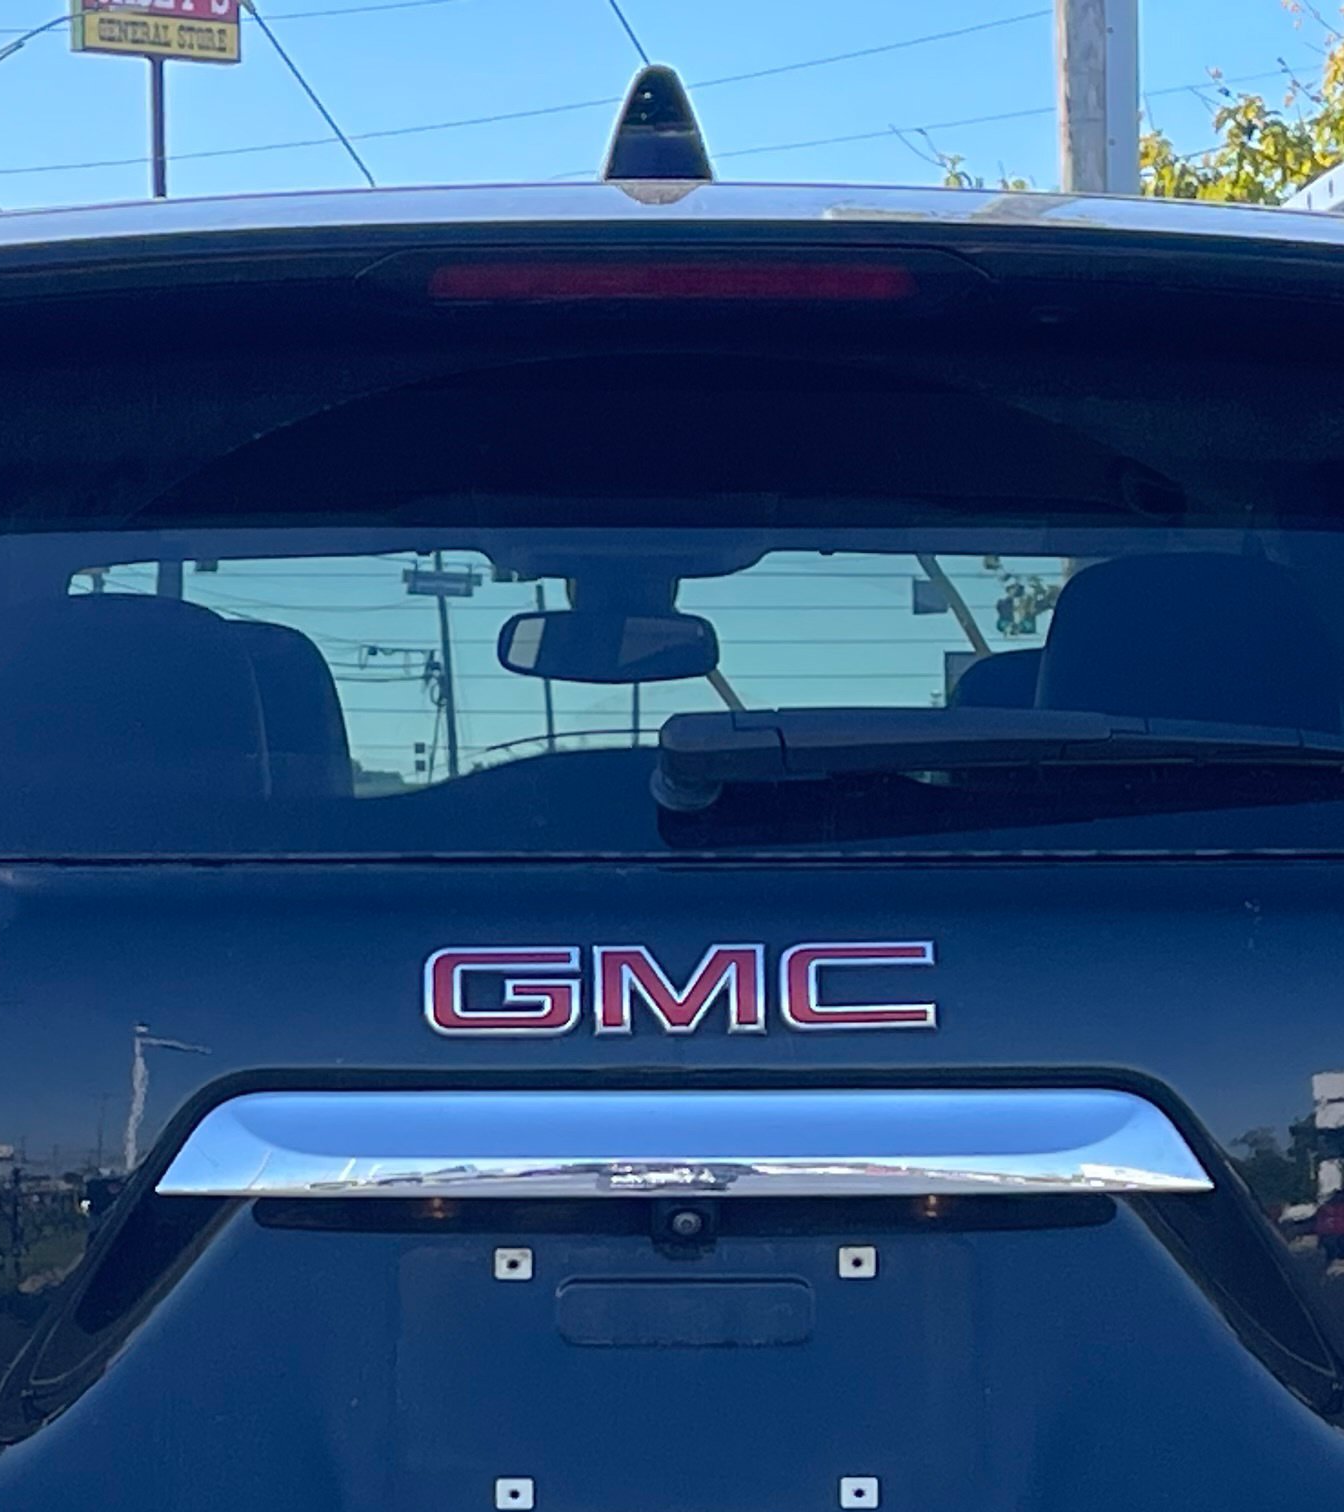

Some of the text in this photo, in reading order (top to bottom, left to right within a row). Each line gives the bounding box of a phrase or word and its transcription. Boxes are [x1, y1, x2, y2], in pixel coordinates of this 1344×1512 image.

[98, 17, 227, 53] GENERAL STORE
[423, 940, 938, 1037] GMC
